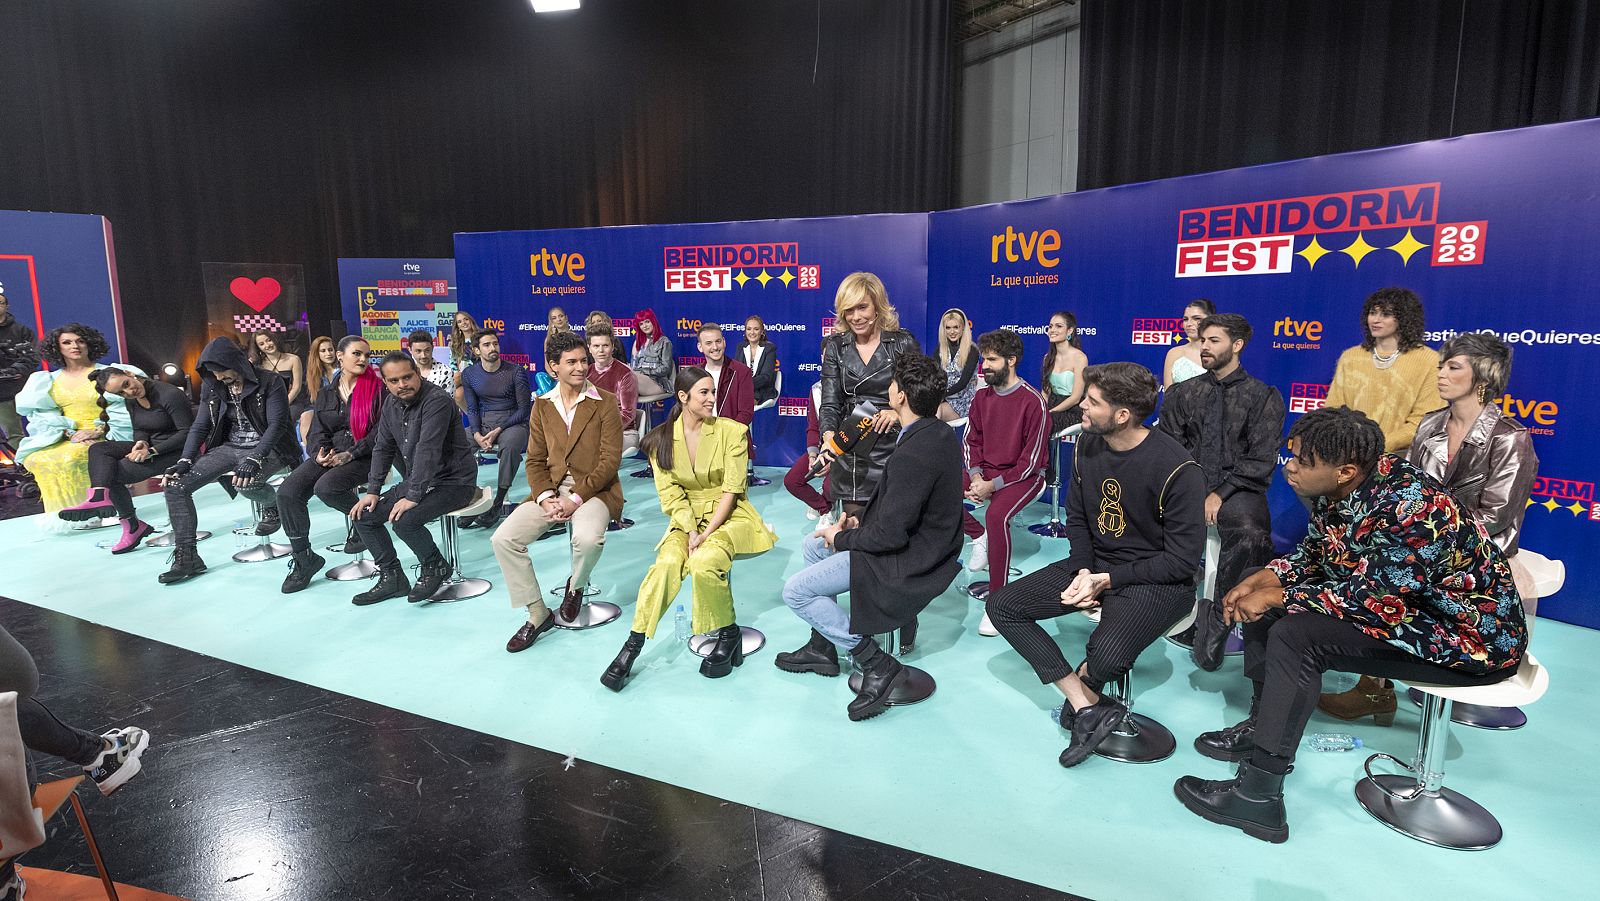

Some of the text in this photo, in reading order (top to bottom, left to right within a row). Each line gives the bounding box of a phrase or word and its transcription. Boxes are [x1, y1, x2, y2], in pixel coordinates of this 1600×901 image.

[1181, 187, 1436, 241] BENIDORM
[1440, 225, 1480, 244] 20
[991, 225, 1061, 268] rtve
[1437, 243, 1476, 263] 23
[666, 244, 796, 267] BENIDORM
[1178, 239, 1290, 274] FEST
[403, 262, 421, 272] rtve
[530, 247, 586, 282] rtve
[800, 267, 818, 277] 20
[378, 280, 432, 288] BENIDORM
[666, 270, 729, 289] FEST
[800, 277, 818, 288] 23
[991, 272, 1059, 289] La que quieres
[378, 288, 405, 296] FEST
[531, 284, 586, 297] La que quieres
[361, 311, 398, 319] AGONEY
[363, 325, 398, 334] BLANCA
[406, 319, 429, 327] ALICE
[483, 317, 505, 331] rtve
[677, 317, 703, 331] rtve
[1273, 316, 1323, 342] rtve
[613, 328, 630, 336] EST
[1132, 332, 1171, 344] FEST
[1272, 341, 1321, 350] La que quieres
[779, 407, 807, 416] FEST
[1290, 398, 1326, 412] FES
